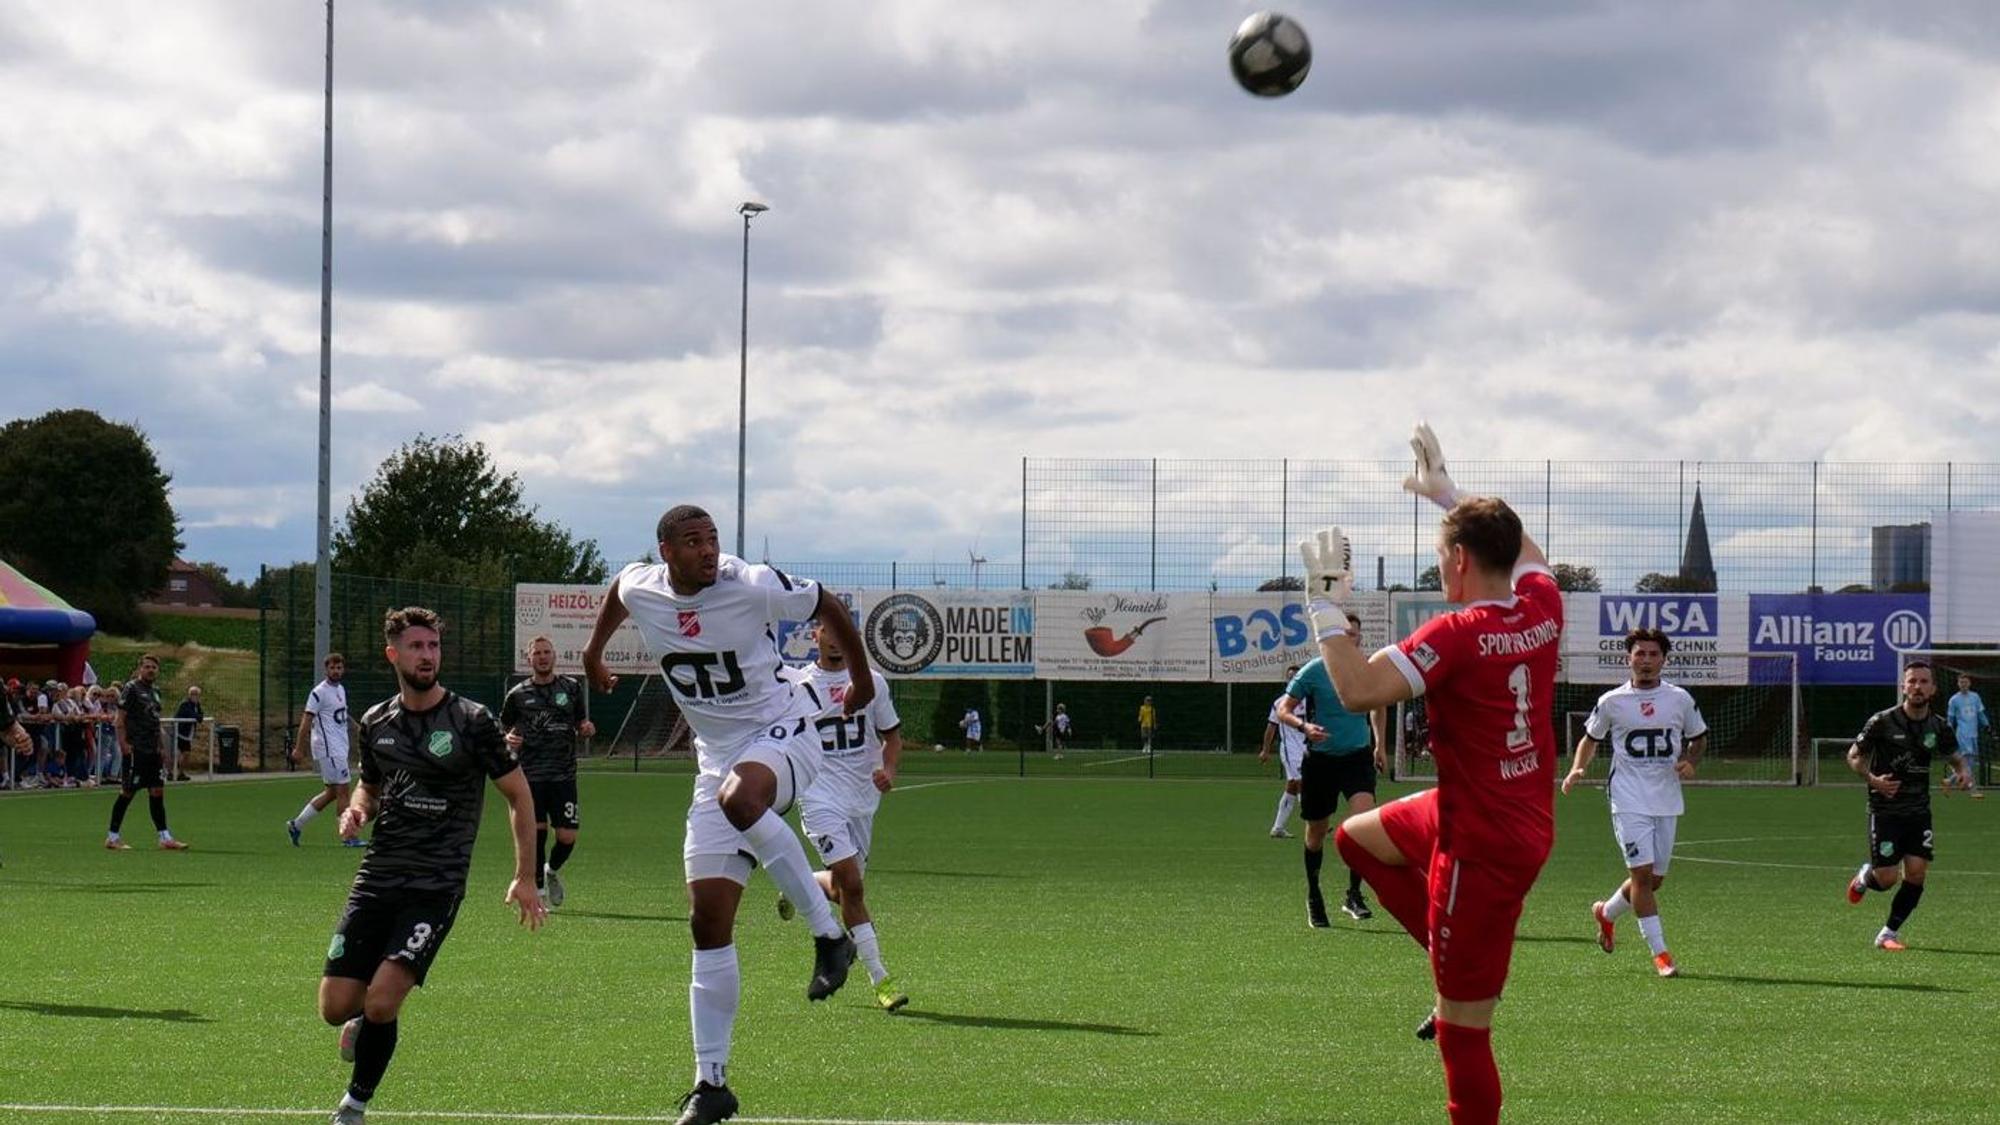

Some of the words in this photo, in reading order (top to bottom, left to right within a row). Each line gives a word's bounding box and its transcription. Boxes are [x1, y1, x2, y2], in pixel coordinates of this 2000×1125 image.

[1606, 602, 1709, 632] WISA
[1754, 615, 1875, 645] Allianz
[946, 637, 1032, 663] PULLEM
[1221, 649, 1313, 673] Signaltechnik
[1815, 646, 1875, 661] Faouzi
[1506, 663, 1534, 752] 1
[1625, 728, 1673, 758] CTS
[407, 922, 432, 951] 3
